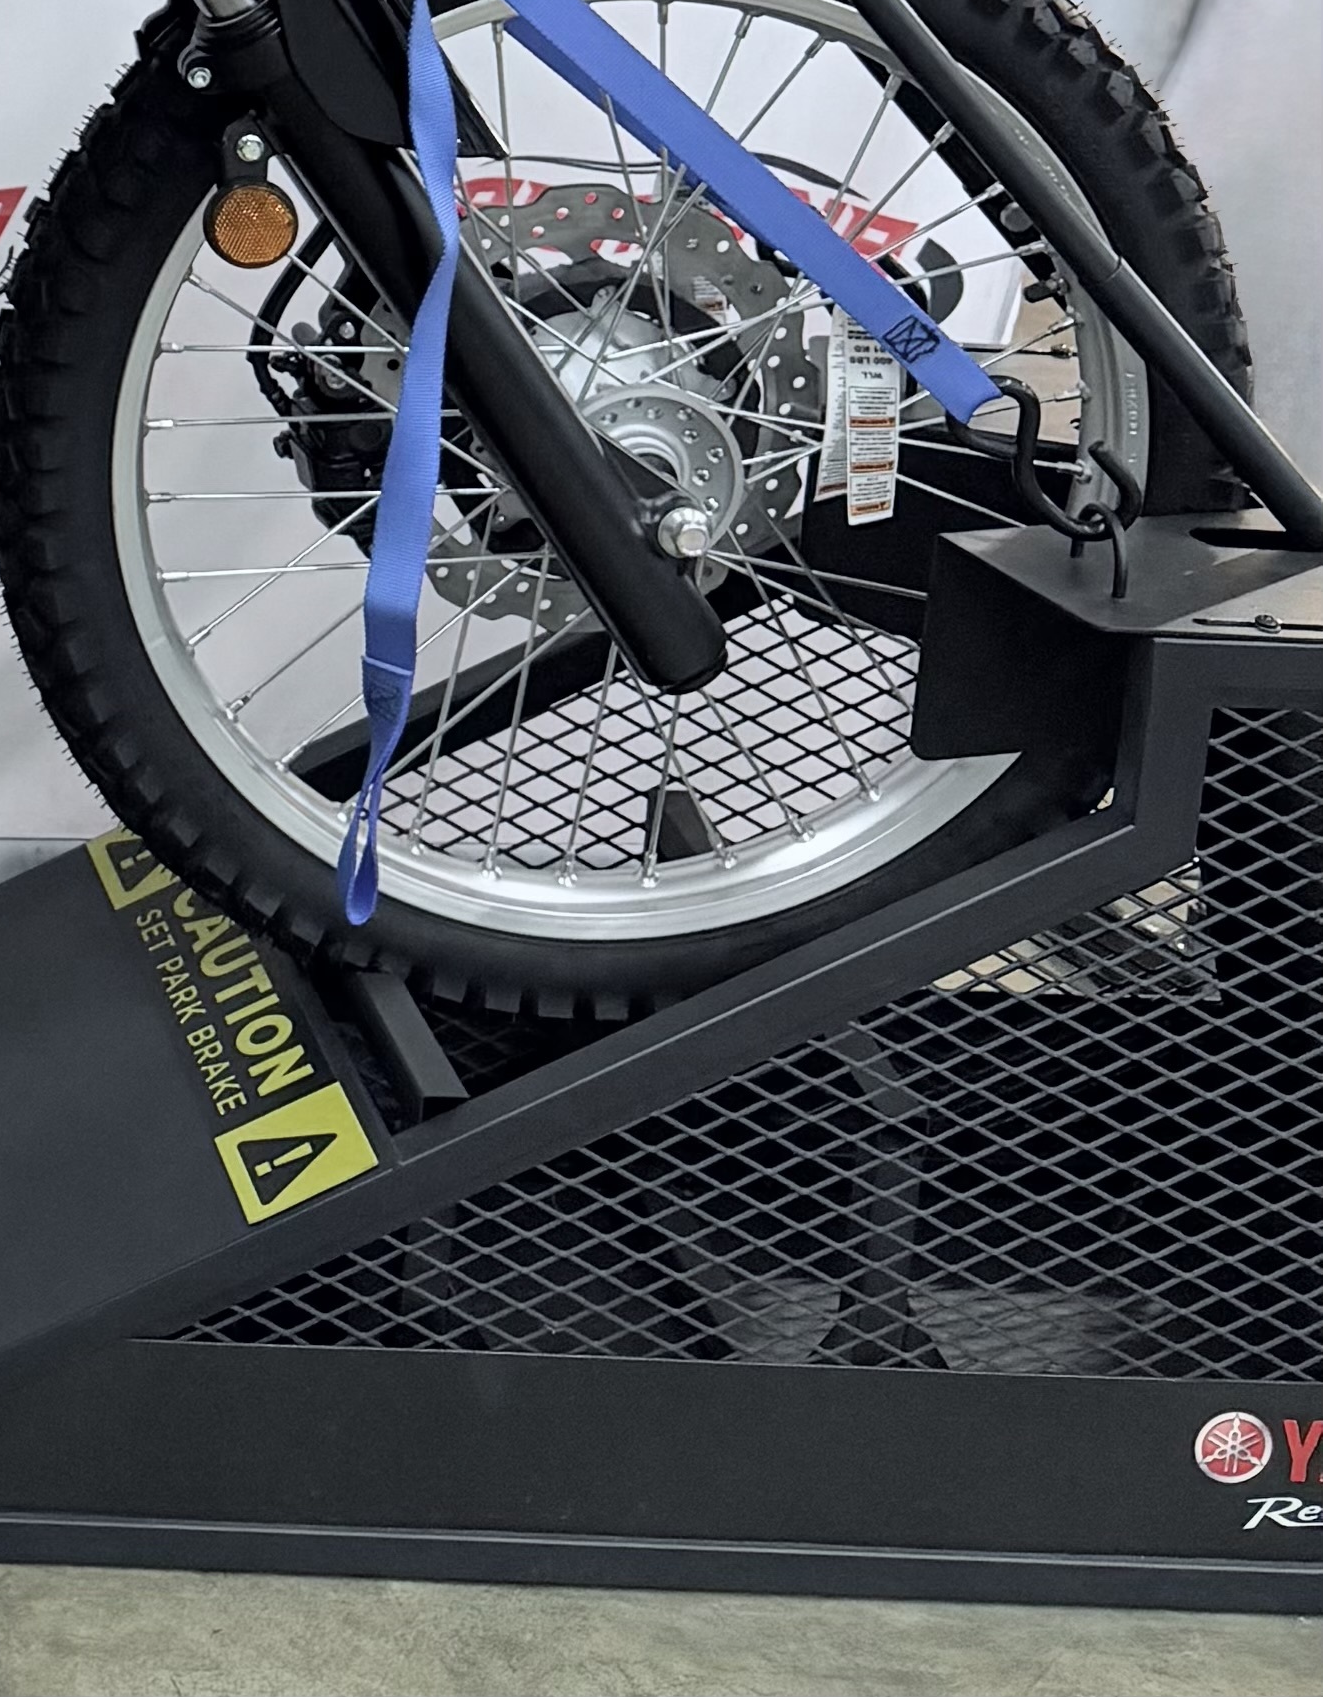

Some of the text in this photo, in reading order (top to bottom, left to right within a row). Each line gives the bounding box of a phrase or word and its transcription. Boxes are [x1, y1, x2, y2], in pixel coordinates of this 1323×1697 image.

[136, 908, 247, 1116] SET PARK BRAKE
